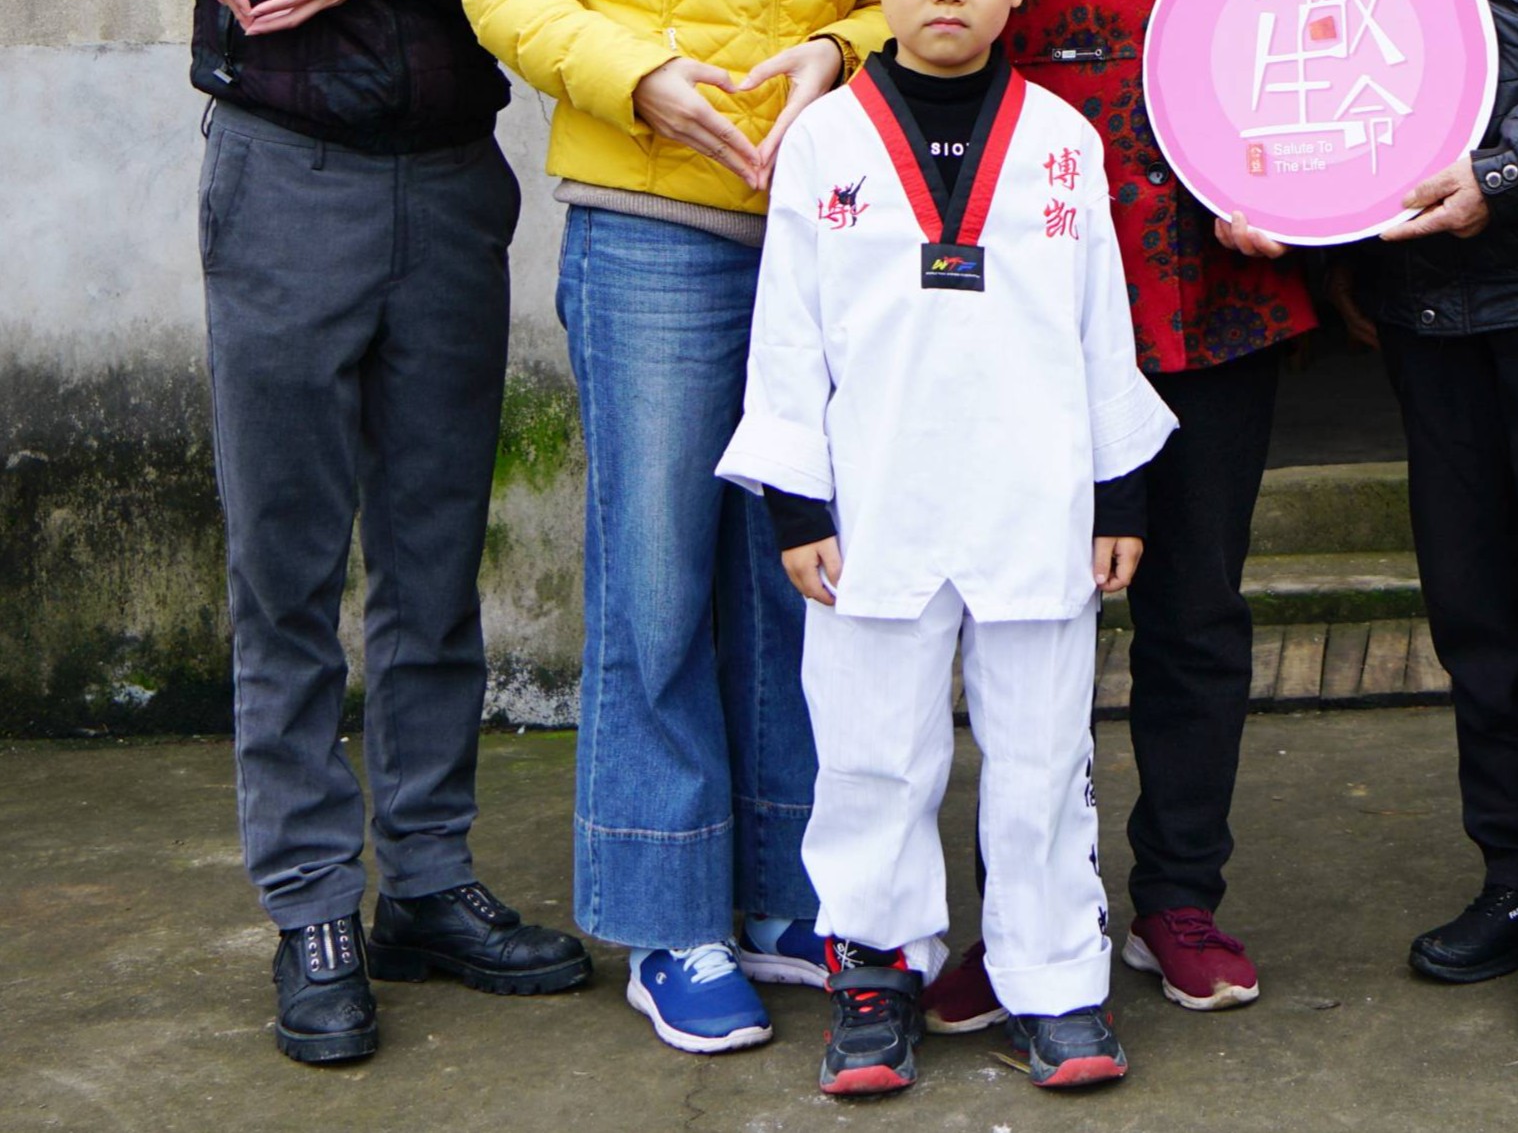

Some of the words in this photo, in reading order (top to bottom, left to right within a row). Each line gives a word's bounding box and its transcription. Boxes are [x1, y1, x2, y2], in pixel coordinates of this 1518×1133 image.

[930, 142, 970, 156] SIO
[1274, 142, 1314, 155] Salute
[1317, 140, 1333, 153] To
[1274, 160, 1299, 173] The
[1303, 158, 1327, 171] Life
